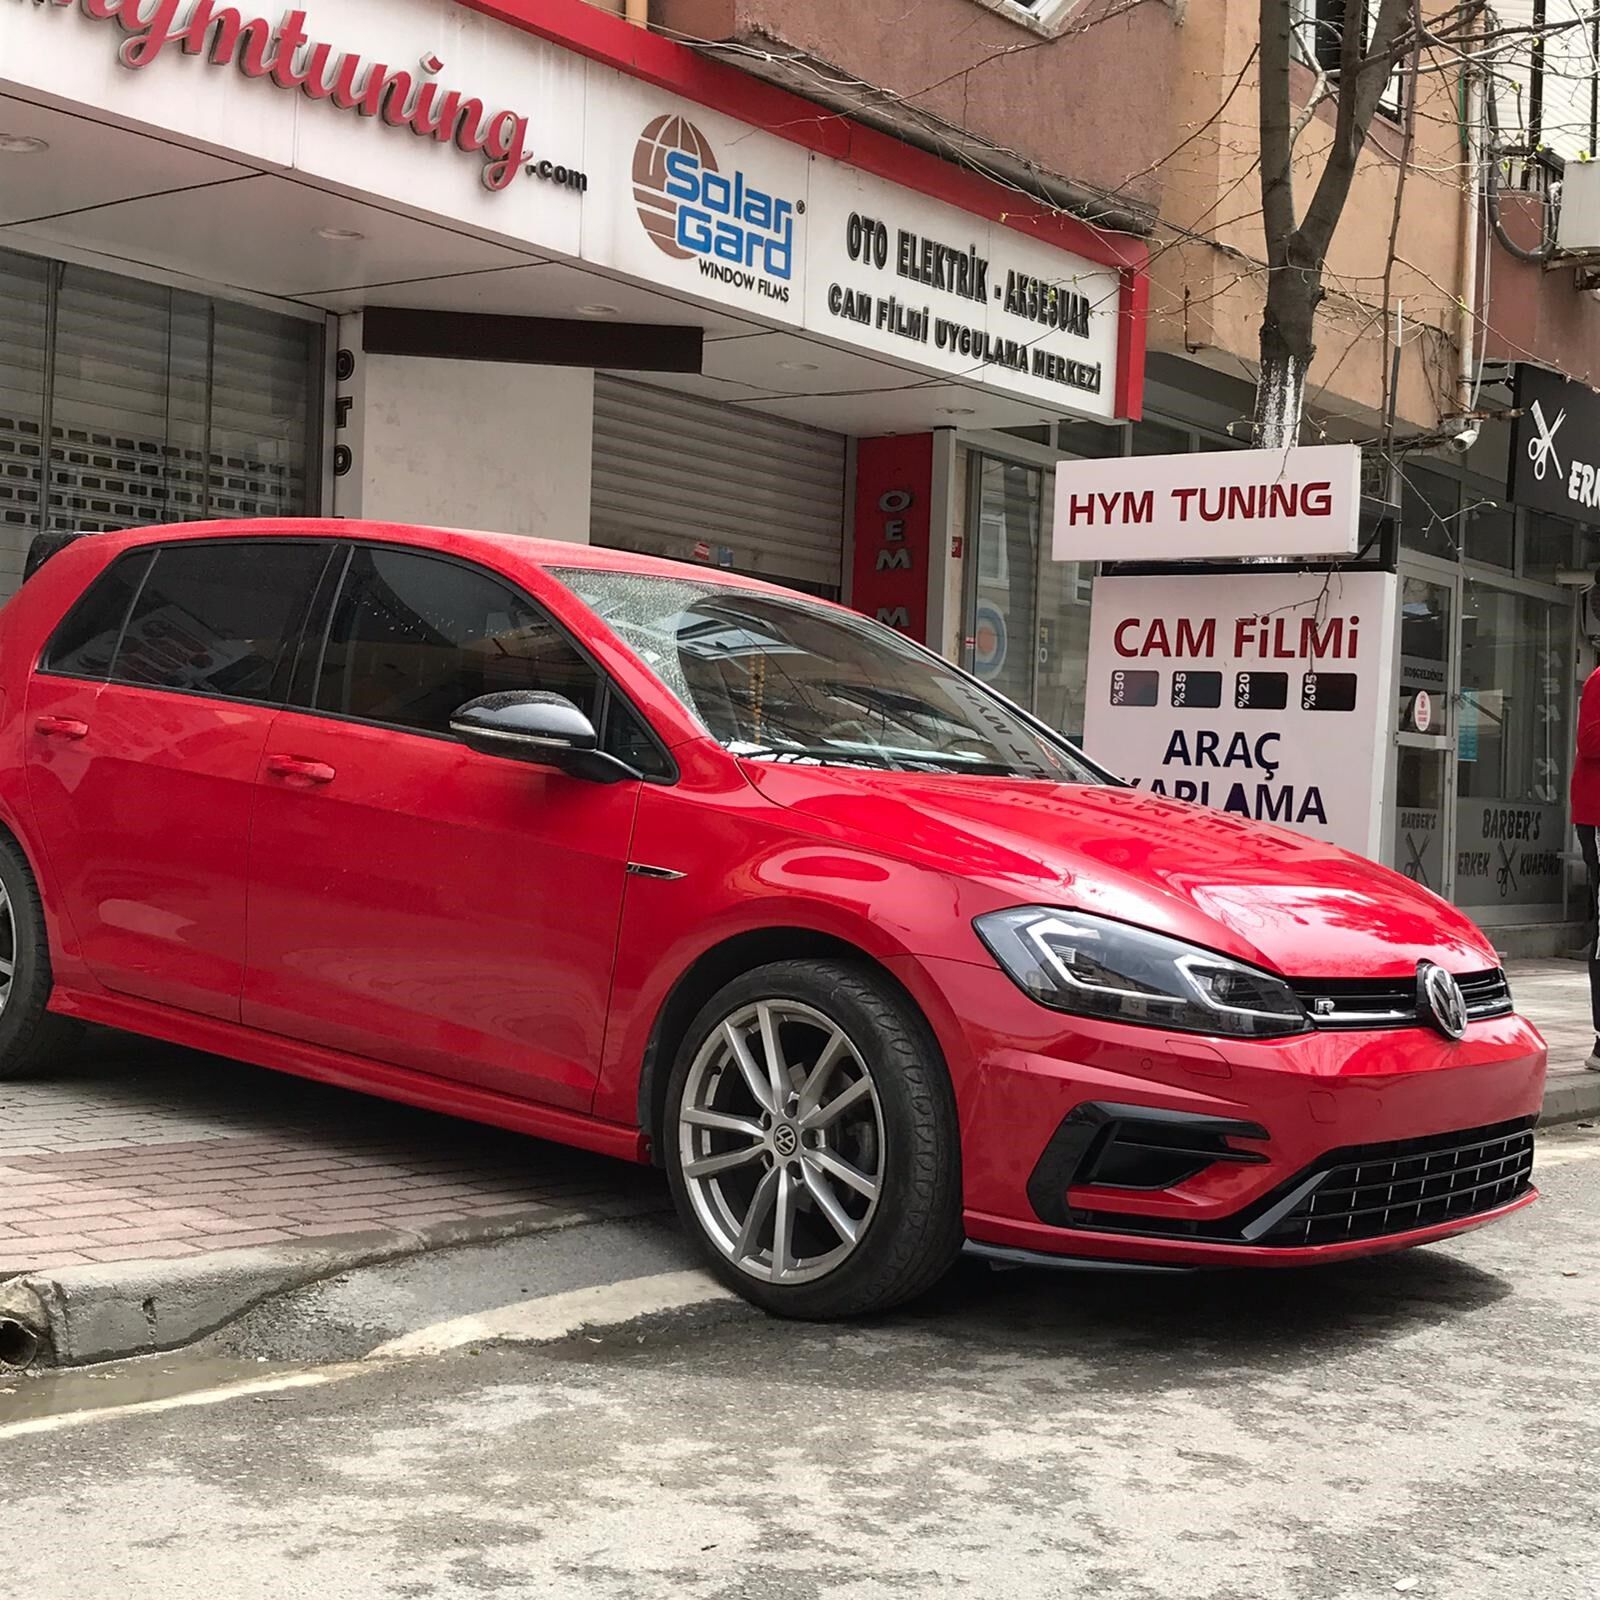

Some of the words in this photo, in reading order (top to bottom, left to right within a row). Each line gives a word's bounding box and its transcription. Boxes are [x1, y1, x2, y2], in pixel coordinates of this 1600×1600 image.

[667, 151, 793, 234] Solar
[677, 205, 793, 280] Gard
[699, 258, 756, 291] WINDOW
[757, 278, 790, 303] FILMS
[846, 211, 889, 270] OTO
[896, 228, 989, 304] ELEKTRİK
[1003, 268, 1091, 339] AKSESUAR
[828, 282, 872, 316] CAM
[875, 294, 930, 344] FİLMİ
[934, 316, 1029, 374] UYGULAMA
[1032, 347, 1102, 394] MERKEZİ
[1069, 490, 1154, 526] HYM
[1171, 481, 1333, 522] TUNING
[876, 489, 913, 571] OEM
[1113, 617, 1217, 658] CAM
[1112, 671, 1125, 705] %50
[1173, 672, 1187, 706] %35
[1237, 672, 1251, 708] %20
[1303, 673, 1317, 709] %05
[1162, 729, 1281, 780] ARAÇ
[1482, 808, 1542, 841] BARBER'S
[1457, 852, 1490, 877] ERKEK
